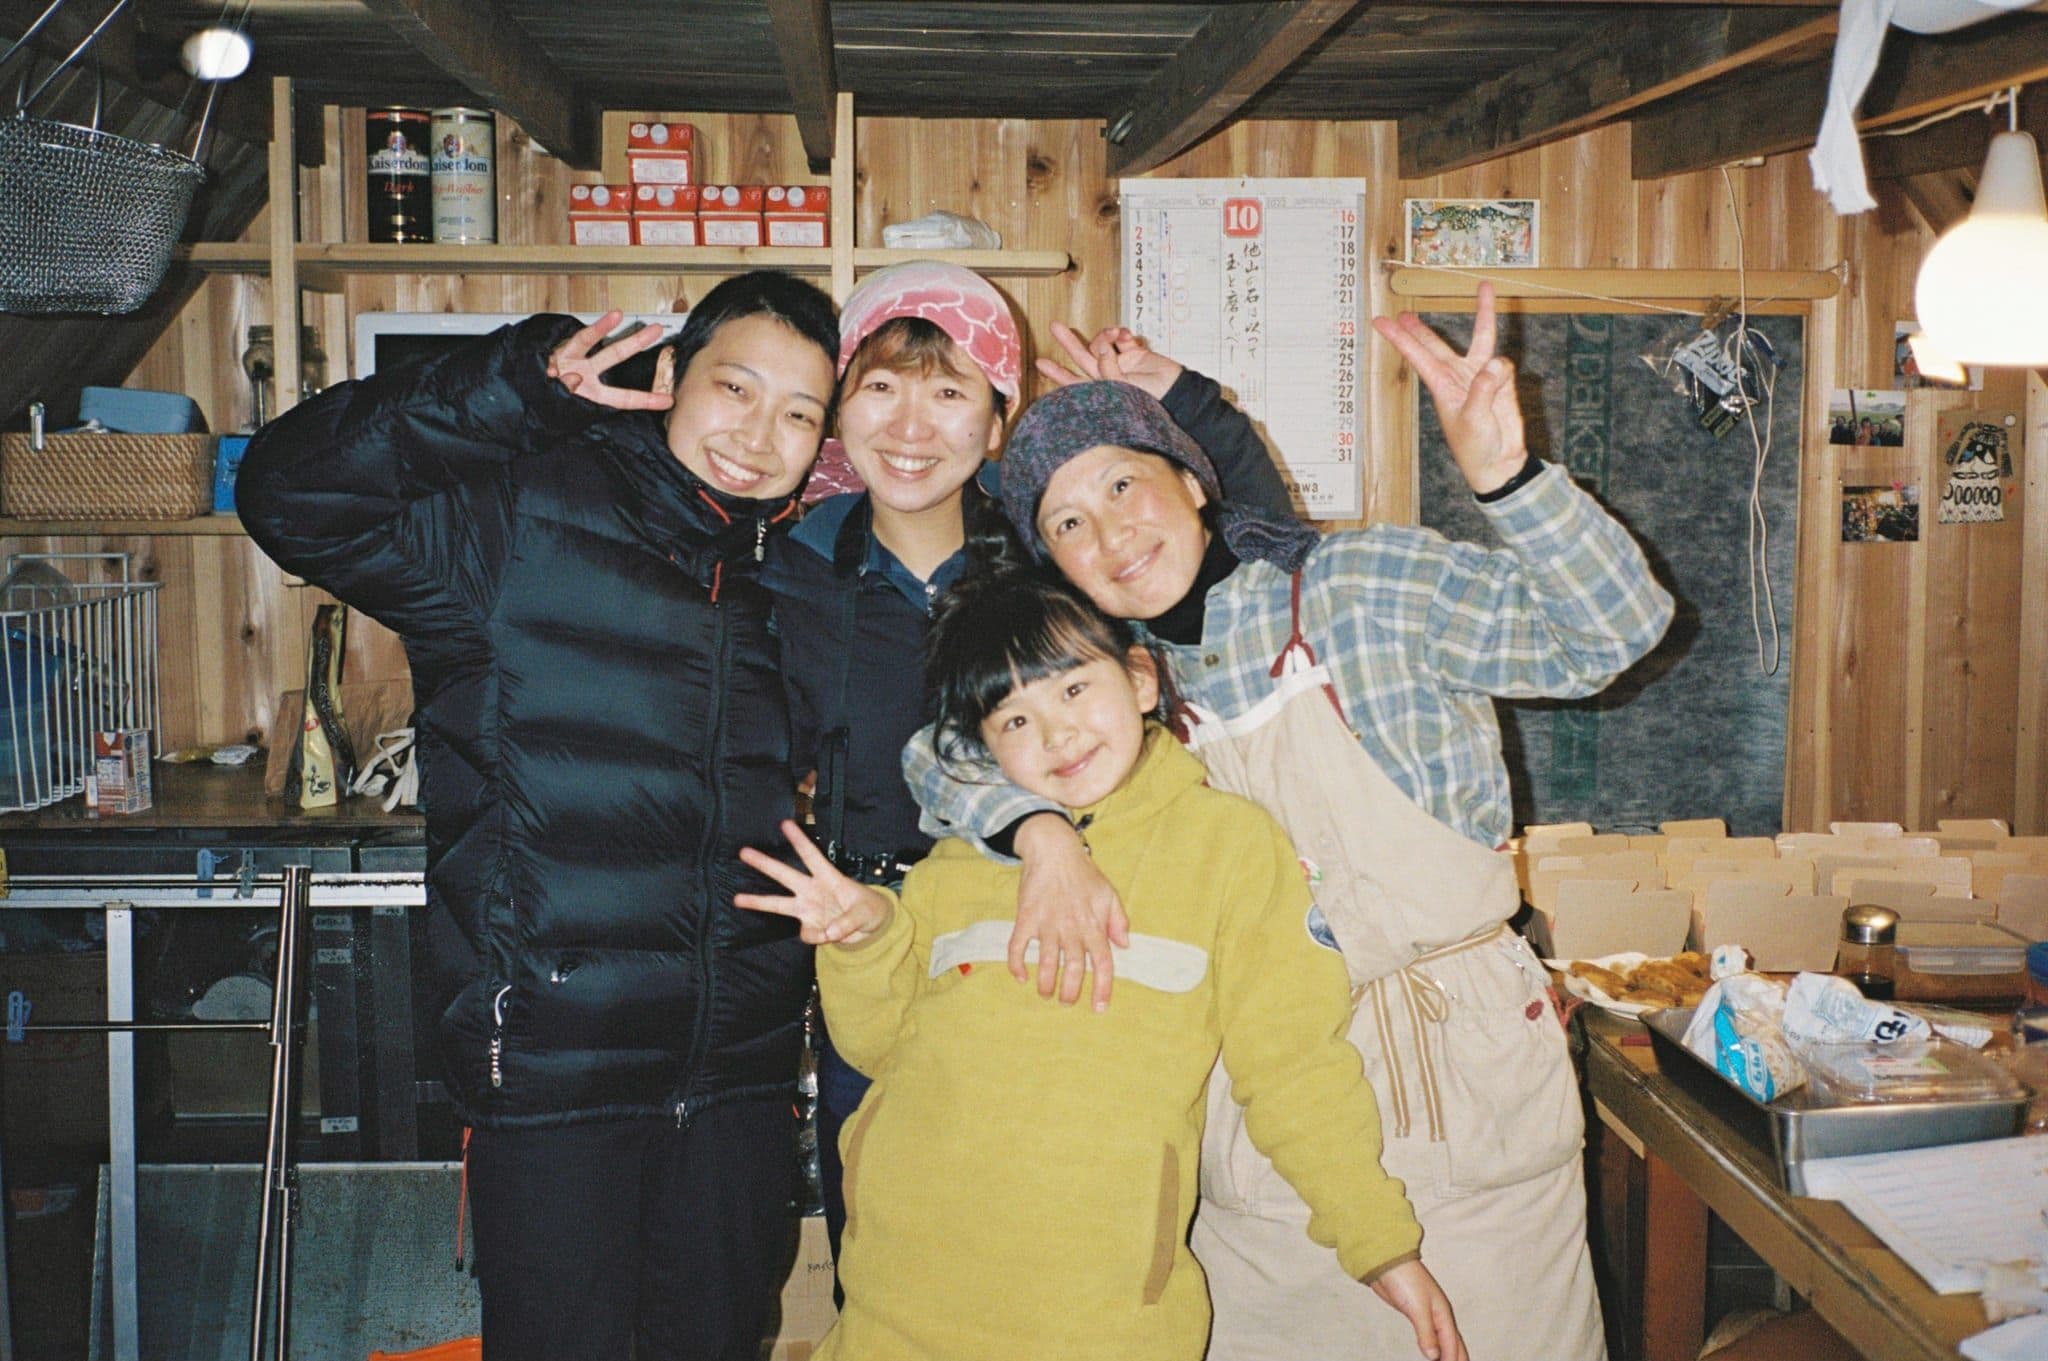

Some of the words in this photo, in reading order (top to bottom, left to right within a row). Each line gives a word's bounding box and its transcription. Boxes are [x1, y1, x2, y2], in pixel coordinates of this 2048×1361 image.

[1228, 205, 1258, 230] 10
[1340, 210, 1355, 223] 16
[1135, 226, 1143, 240] 2
[1340, 226, 1355, 239] 17
[1135, 242, 1143, 256] 3
[1340, 242, 1355, 255] 18
[1135, 258, 1143, 271] 4
[1340, 258, 1355, 271] 19
[1135, 274, 1144, 288] 5
[1339, 274, 1355, 287] 20
[1135, 290, 1144, 304] 6
[1339, 290, 1354, 303] 21
[1135, 306, 1144, 320] 7
[1339, 306, 1354, 319] 22
[1339, 322, 1354, 335] 23
[1339, 338, 1354, 351] 24
[1339, 353, 1354, 366] 25
[1339, 369, 1354, 382] 26
[1339, 385, 1354, 398] 27
[1339, 401, 1354, 414] 28
[1339, 416, 1353, 430] 29
[1338, 432, 1354, 446] 30
[1338, 448, 1353, 461] 31
